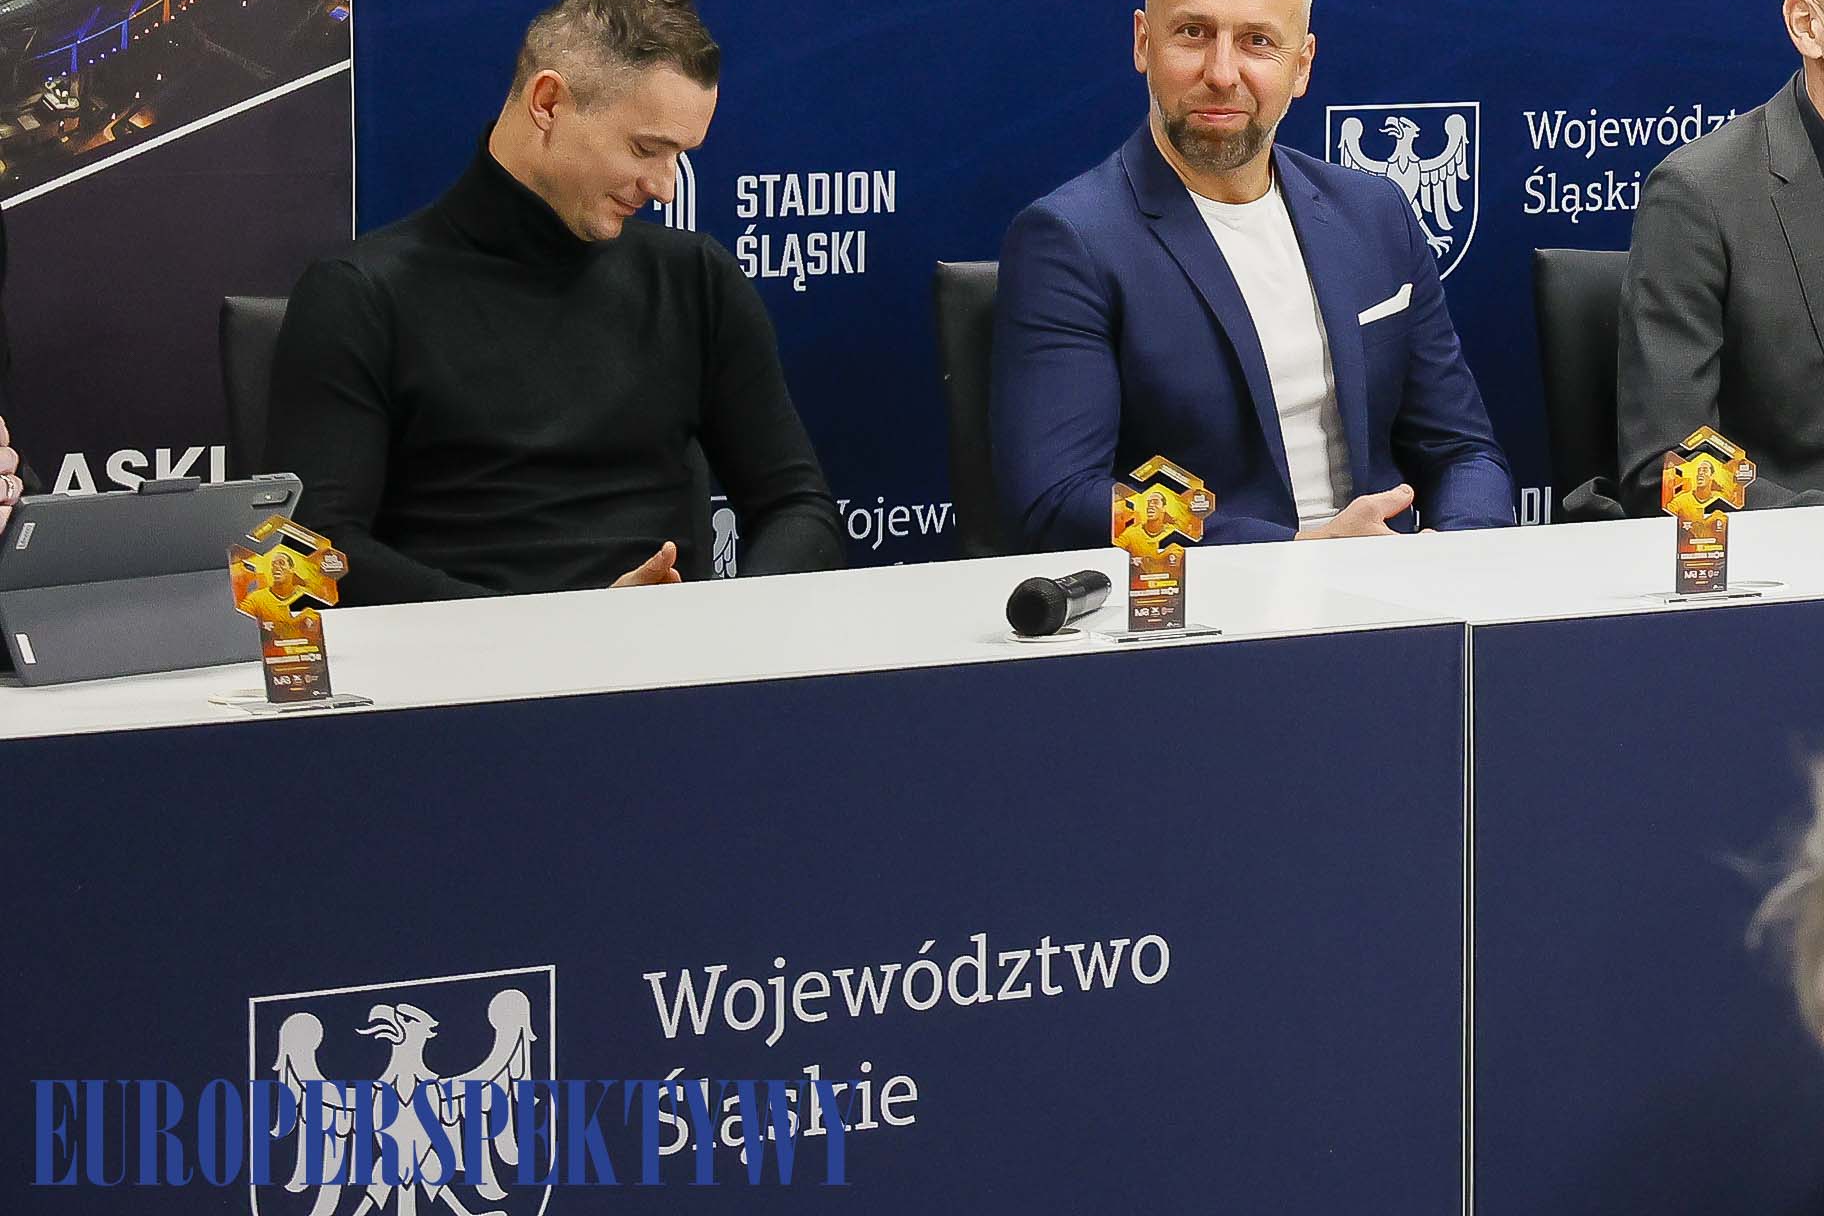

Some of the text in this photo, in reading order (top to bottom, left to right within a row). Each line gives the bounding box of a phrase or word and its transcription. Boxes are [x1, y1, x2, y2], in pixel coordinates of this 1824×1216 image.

[736, 170, 896, 217] STADION
[1523, 165, 1641, 224] Śląski
[736, 224, 867, 292] ŚLĄSKI
[837, 497, 956, 550] ojew
[642, 932, 1171, 1048] Województwo
[651, 1062, 919, 1165] Śląskie
